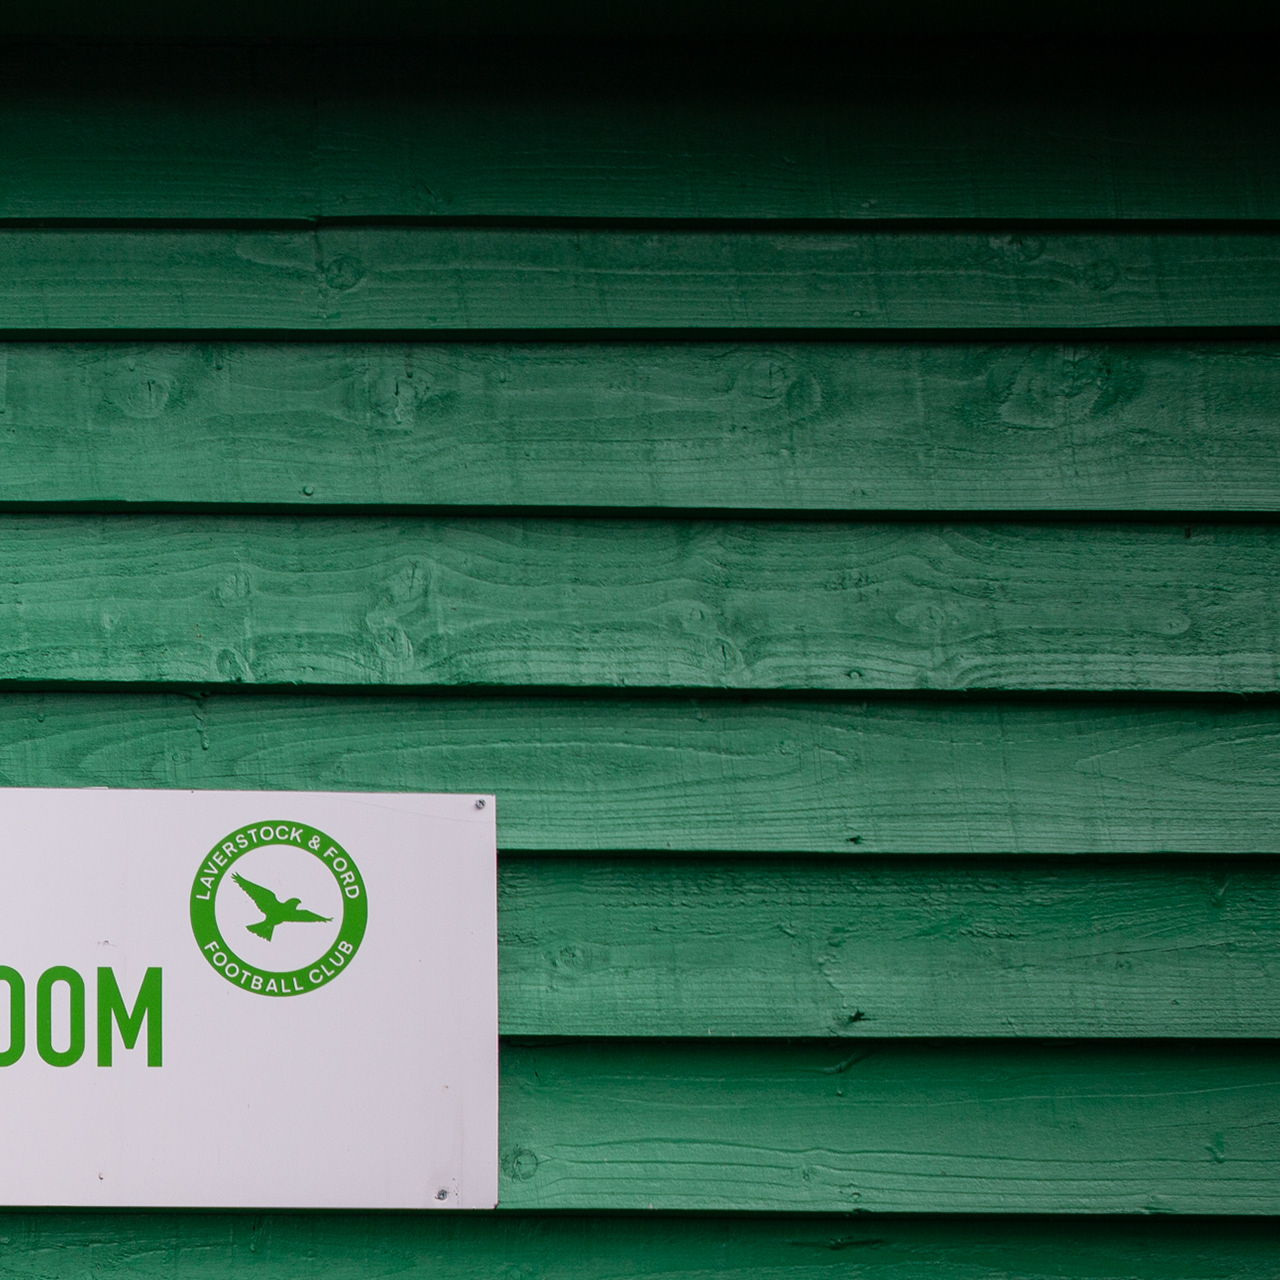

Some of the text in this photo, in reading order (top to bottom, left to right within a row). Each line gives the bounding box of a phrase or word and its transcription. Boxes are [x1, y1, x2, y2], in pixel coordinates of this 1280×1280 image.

[195, 825, 360, 901] LAVERSTOCK & FORD
[204, 940, 354, 994] FOOTBALL CLUB
